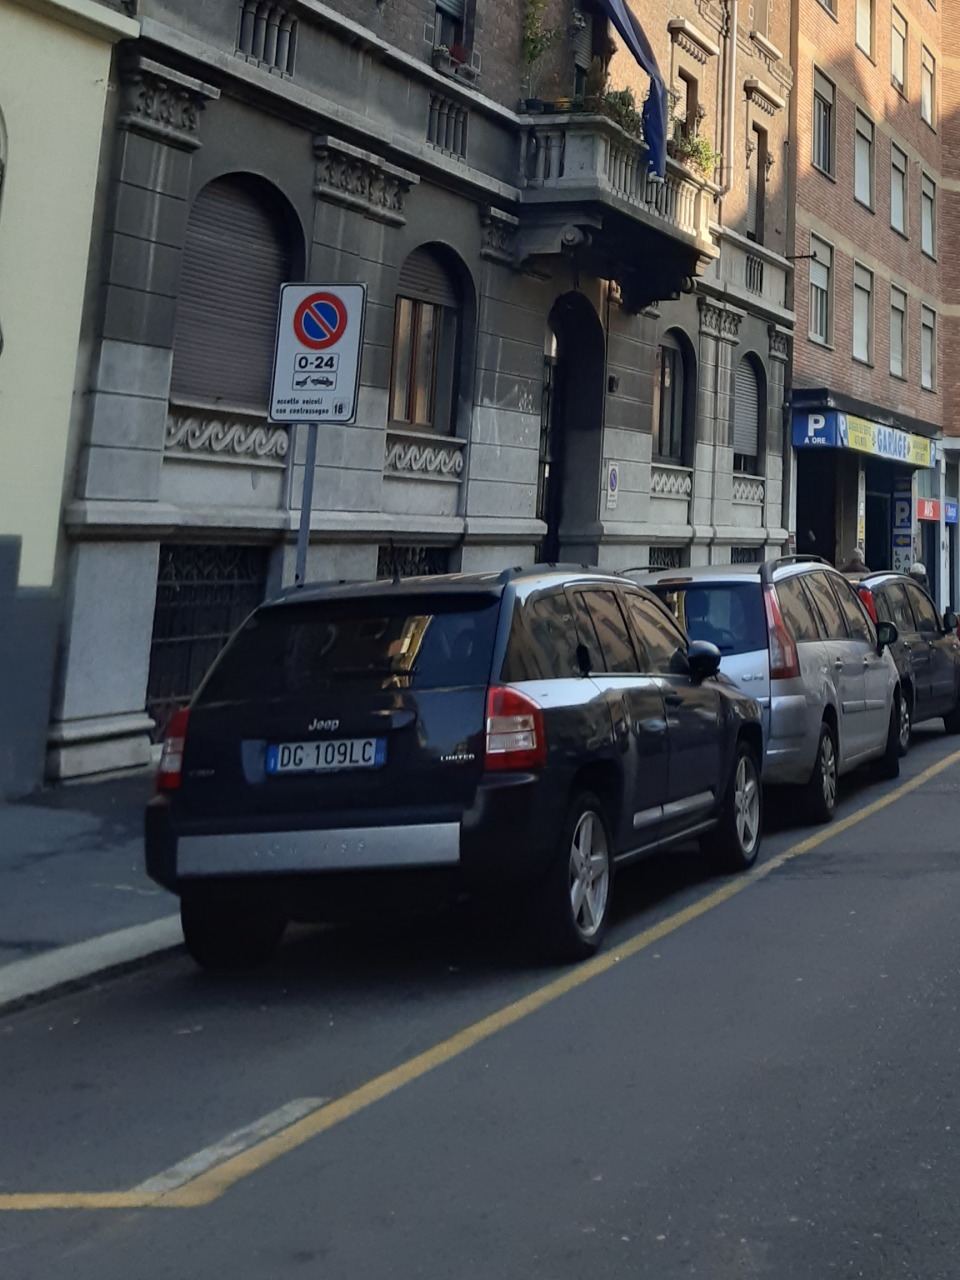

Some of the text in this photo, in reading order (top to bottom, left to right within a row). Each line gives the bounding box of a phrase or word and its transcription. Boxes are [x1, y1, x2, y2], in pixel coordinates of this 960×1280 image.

[298, 356, 335, 369] 0-24
[302, 397, 323, 405] veicoli
[289, 406, 329, 415] contrassegno
[334, 403, 344, 415] 18
[807, 414, 825, 436] P
[811, 436, 826, 444] ORE
[877, 427, 907, 459] GARAGE
[895, 500, 910, 527] P
[308, 718, 340, 731] Jeep
[280, 740, 373, 768] DG 109LC
[440, 753, 475, 762] LIMITED
